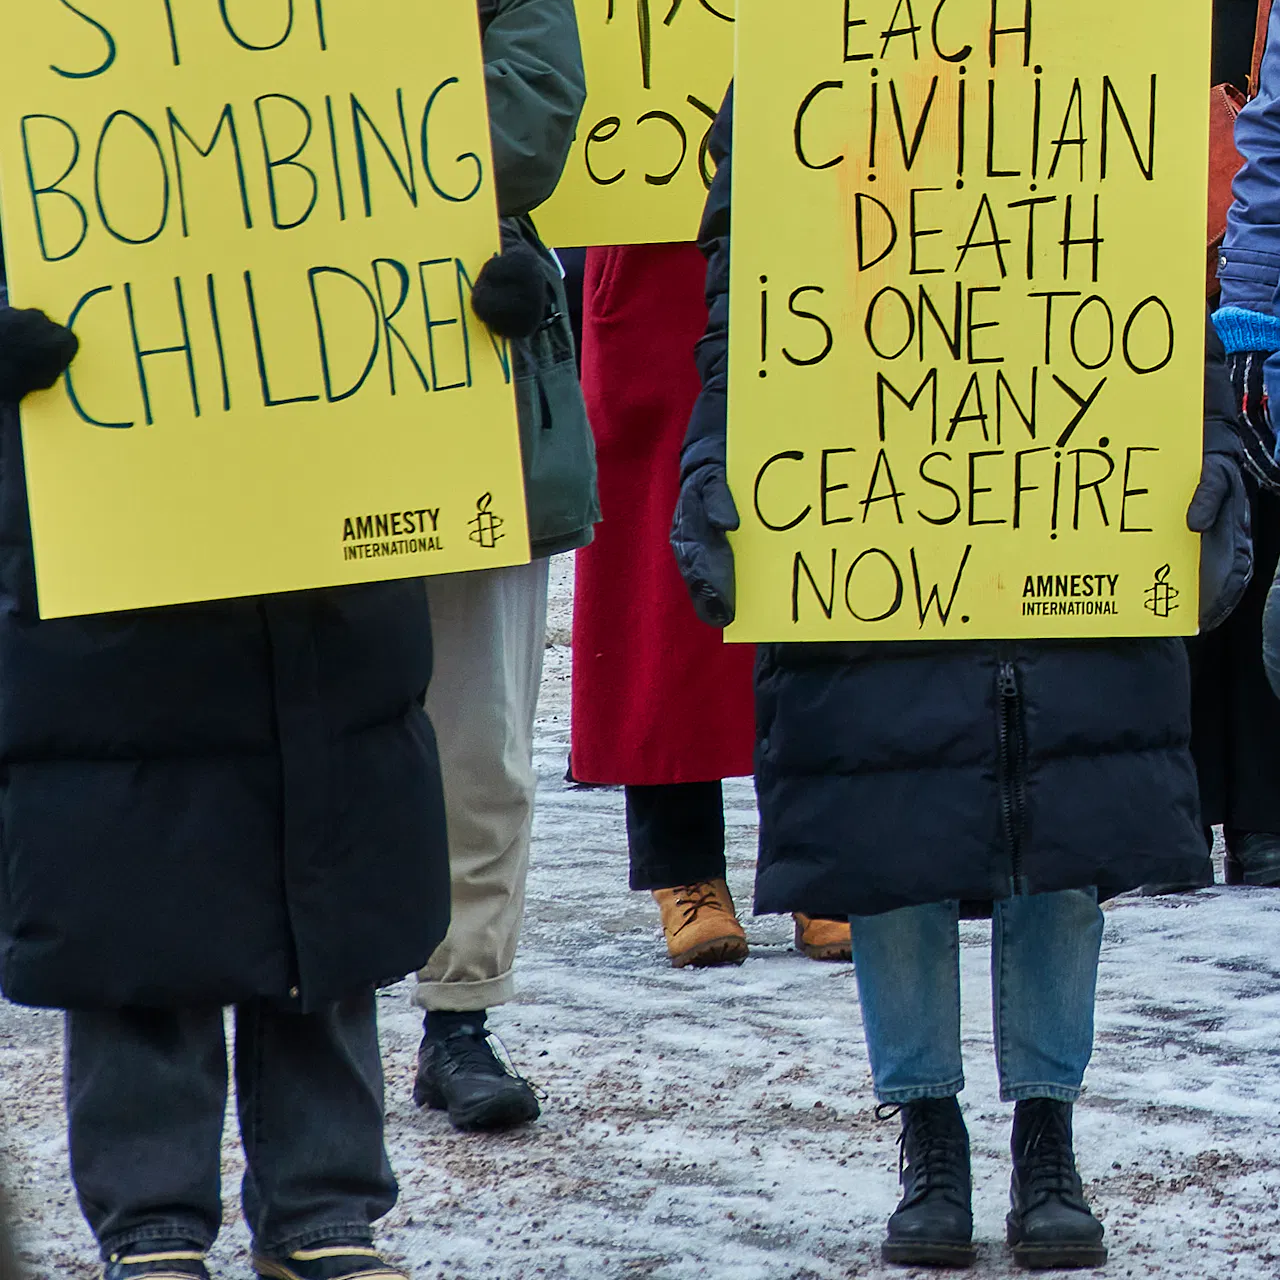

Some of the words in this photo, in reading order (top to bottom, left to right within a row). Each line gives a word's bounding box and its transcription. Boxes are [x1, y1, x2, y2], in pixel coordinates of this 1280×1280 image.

[21, 76, 484, 263] BOMBING
[854, 187, 1104, 282] DEATH
[63, 251, 512, 430] CHILDREN
[864, 282, 1004, 365] ONE
[1027, 291, 1175, 374] TOO
[342, 507, 440, 542] AMNESTY
[753, 445, 1160, 539] CEASEFIRE
[344, 536, 443, 561] INTERNATIONAL
[791, 545, 973, 630] NOW.
[1022, 574, 1119, 597] AMNESTY
[1022, 601, 1119, 616] INTERNATIONAL
